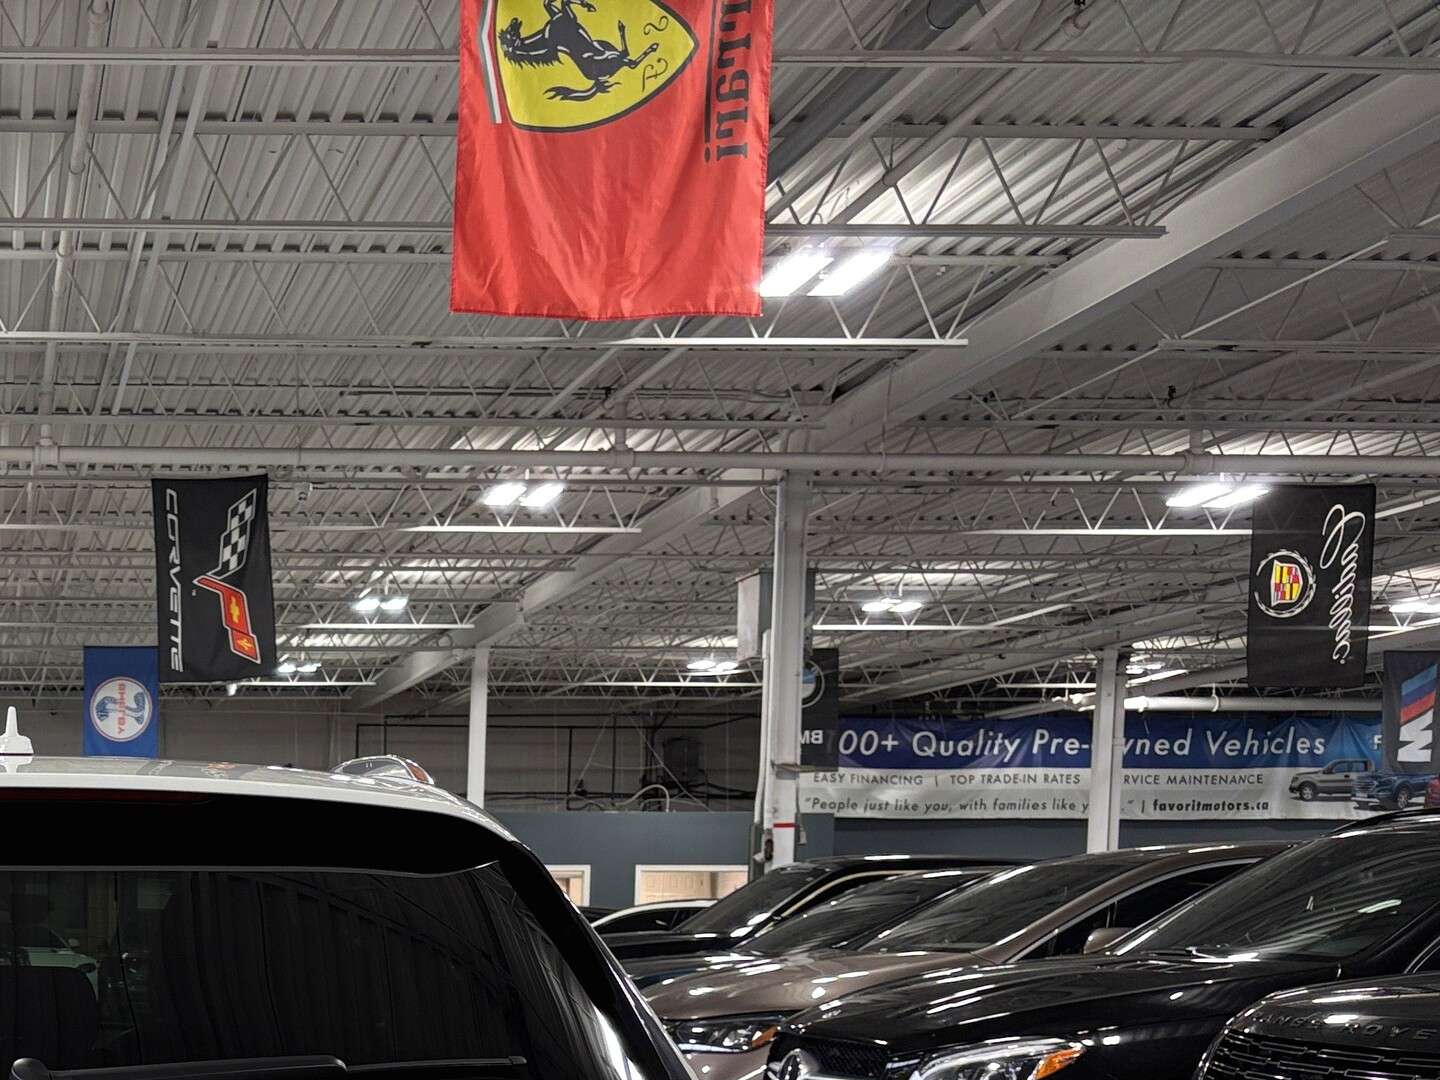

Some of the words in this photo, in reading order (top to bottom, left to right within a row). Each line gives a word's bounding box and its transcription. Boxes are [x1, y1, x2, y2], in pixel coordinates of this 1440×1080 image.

[166, 488, 183, 672] CORVETTE
[828, 729, 899, 756] 00+
[912, 728, 1021, 763] Quality
[1206, 726, 1326, 756] Vehicles
[813, 773, 846, 783] EASY
[850, 774, 924, 785] FINANCING
[950, 774, 976, 784] TOP
[980, 773, 1037, 785] TRADE-IN
[1043, 773, 1081, 784] RATES
[1123, 774, 1160, 785] RVICE
[1166, 774, 1264, 785] MAINTENANCE
[863, 798, 890, 813] just
[895, 798, 919, 811] like
[924, 800, 952, 814] you,
[959, 797, 987, 811] with
[992, 797, 1047, 811] families
[1052, 799, 1077, 811] like
[1152, 799, 1269, 812] favoritmotors.ca
[1341, 1021, 1440, 1041] ROVE
